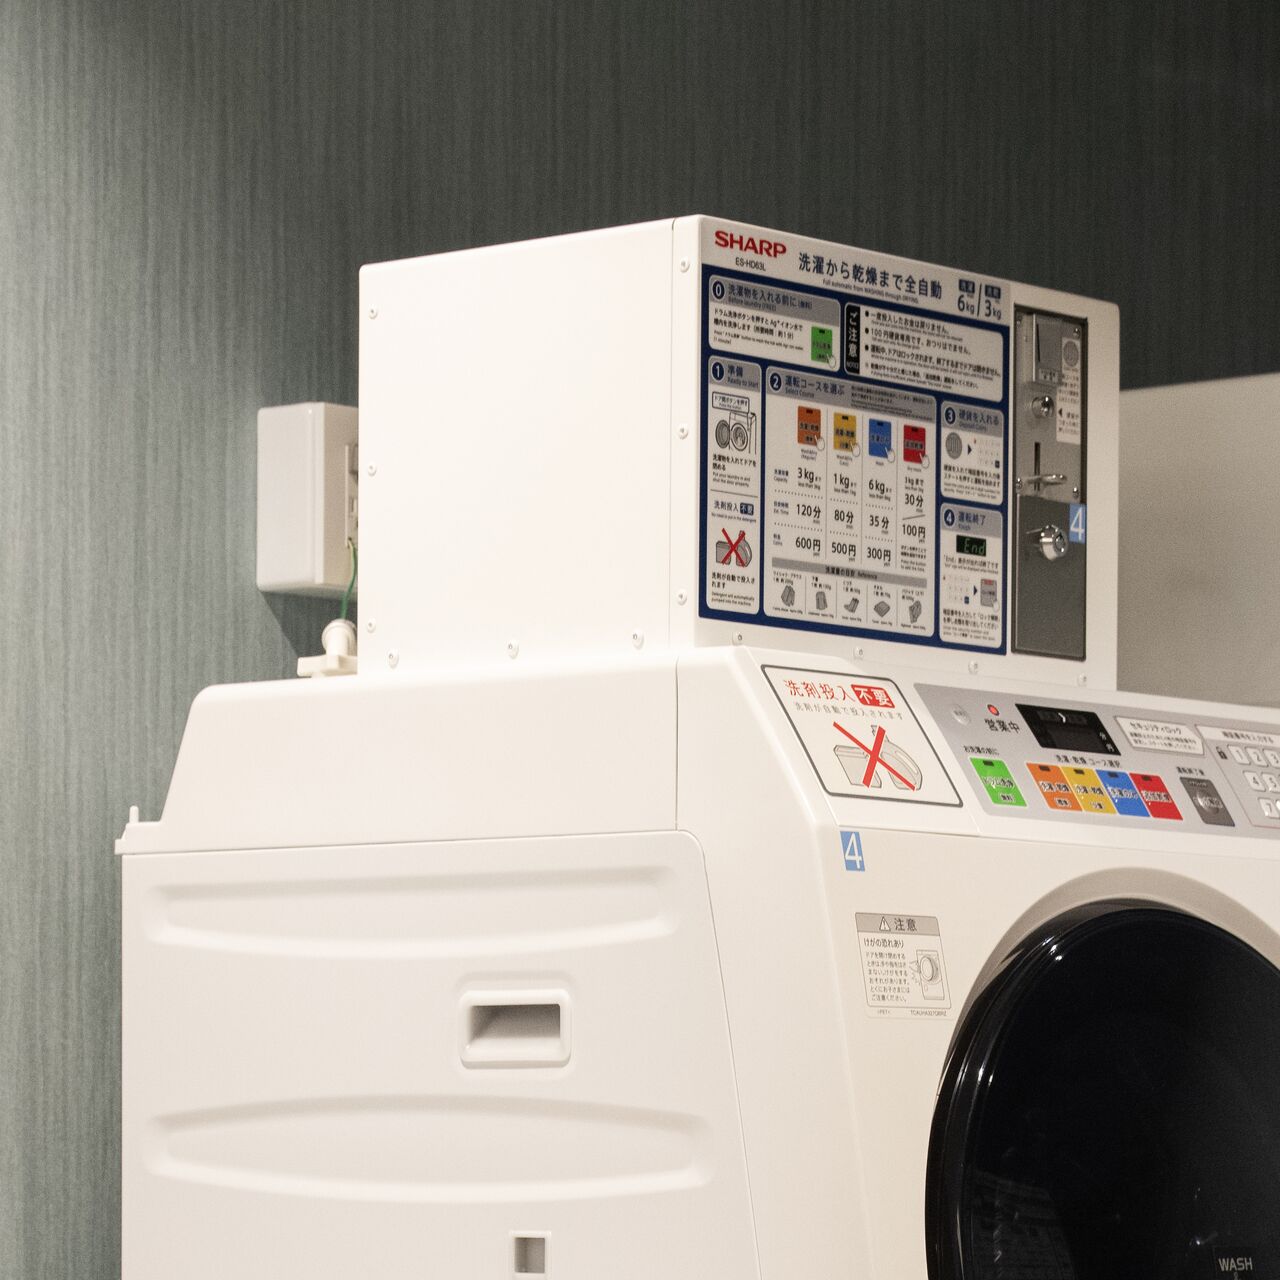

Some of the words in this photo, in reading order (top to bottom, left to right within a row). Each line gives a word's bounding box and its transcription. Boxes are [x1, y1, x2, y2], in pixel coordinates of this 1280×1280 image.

[715, 230, 787, 258] SHARP
[799, 252, 942, 299] 洗濯から乾燥まで全自動
[848, 311, 859, 358] ご注意
[727, 365, 743, 377] 準備
[785, 375, 845, 396] 運転コースを選ぶ
[798, 467, 815, 482] 3kg
[834, 473, 850, 488] 1kg
[869, 480, 885, 494] 6kg
[905, 494, 924, 508] 30分
[796, 504, 821, 519] 120分
[834, 510, 853, 524] 80分
[958, 510, 986, 526] 運転終了
[869, 515, 889, 530] 35分
[1070, 507, 1085, 540] 4
[902, 524, 925, 538] 100円
[795, 536, 821, 552] 600円
[831, 542, 856, 558] 500円
[964, 538, 986, 555] End
[867, 547, 891, 562] 300円
[783, 680, 856, 702] 洗剤投入
[854, 687, 894, 707] 不要
[984, 719, 1020, 734] 営業中
[845, 832, 862, 869] 4
[894, 919, 918, 931] 注意
[863, 937, 904, 949] けがの恐れあり
[1218, 1257, 1253, 1271] WASH
